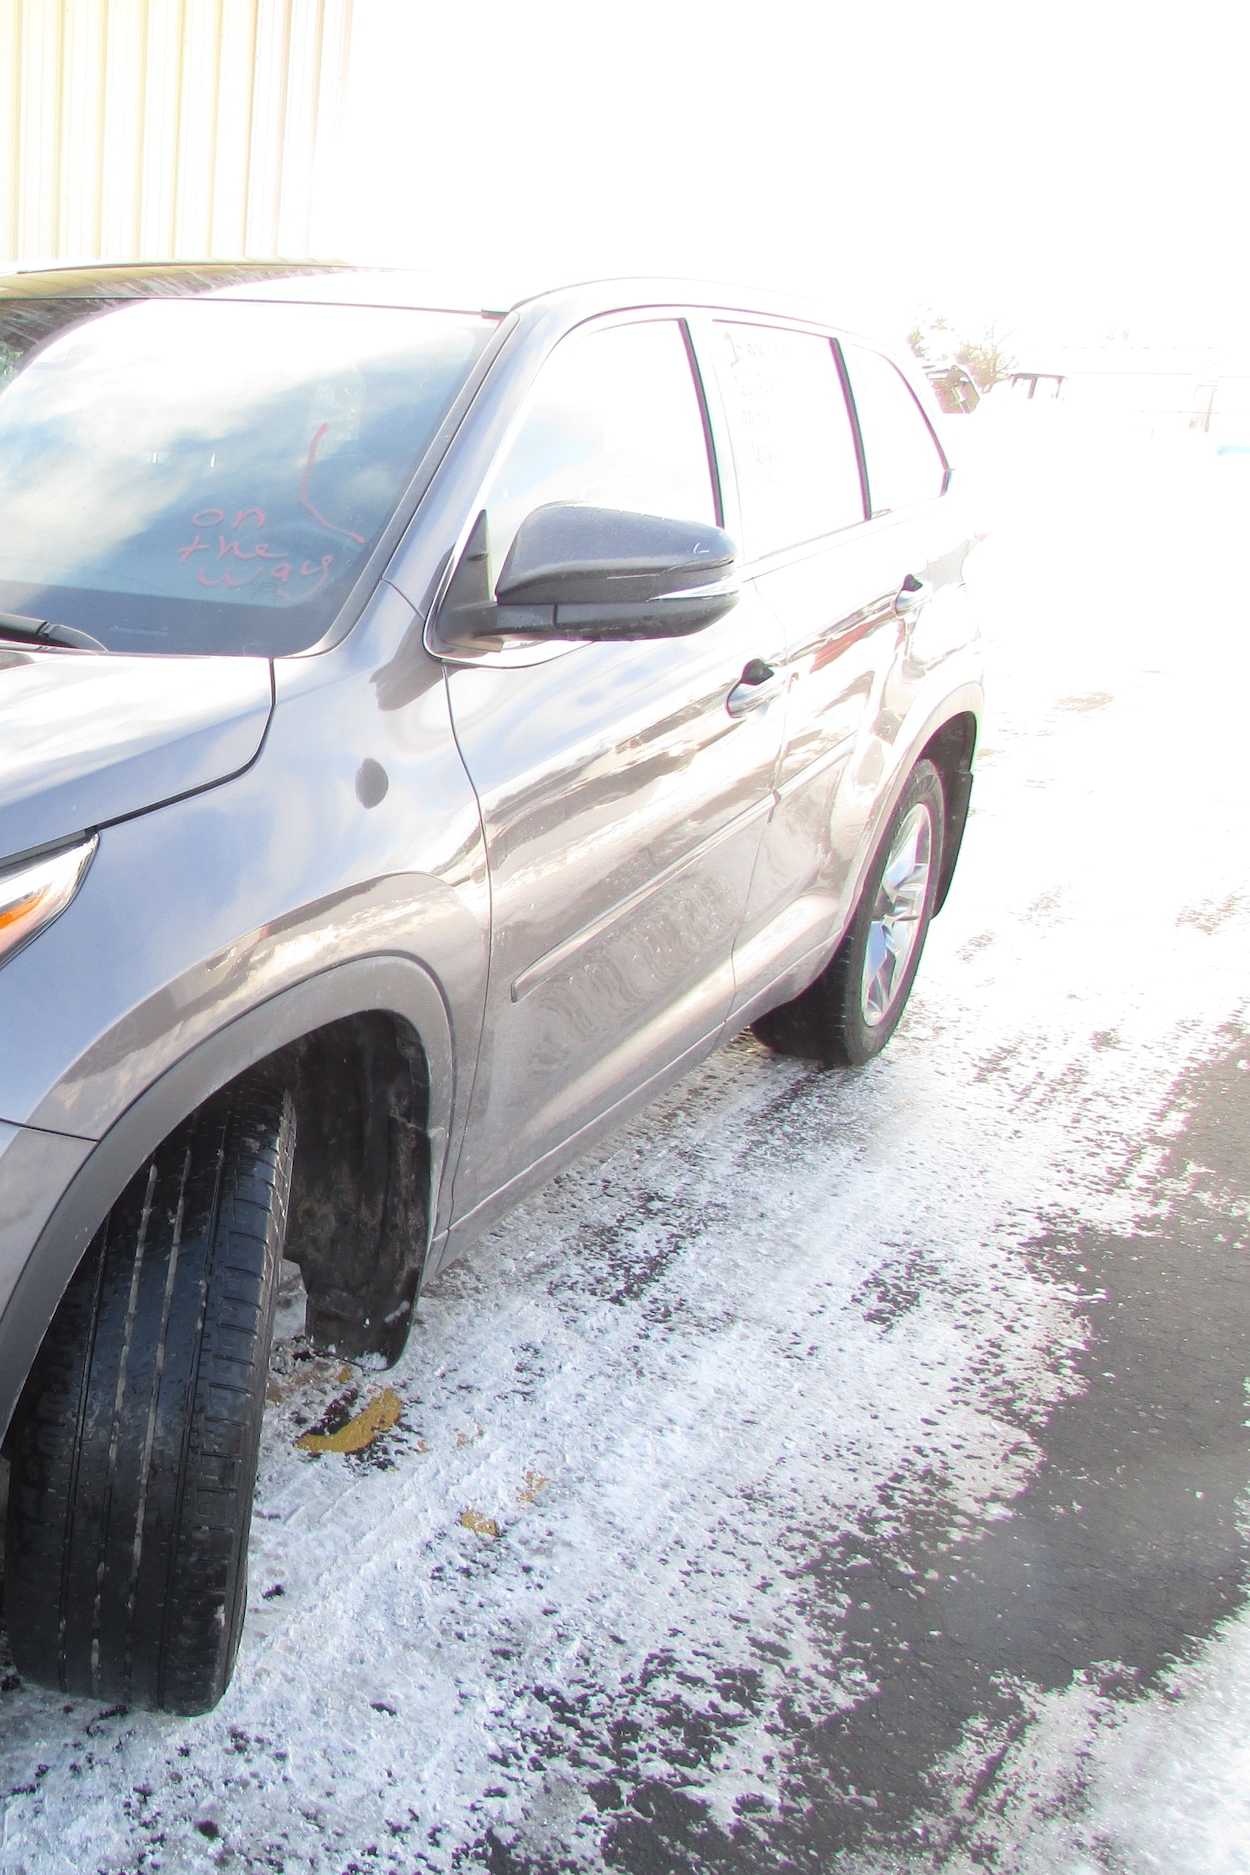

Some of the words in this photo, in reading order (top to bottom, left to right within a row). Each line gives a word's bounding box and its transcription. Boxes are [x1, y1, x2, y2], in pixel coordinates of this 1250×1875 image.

[192, 507, 266, 530] on
[177, 535, 289, 564] the
[198, 554, 333, 601] way
